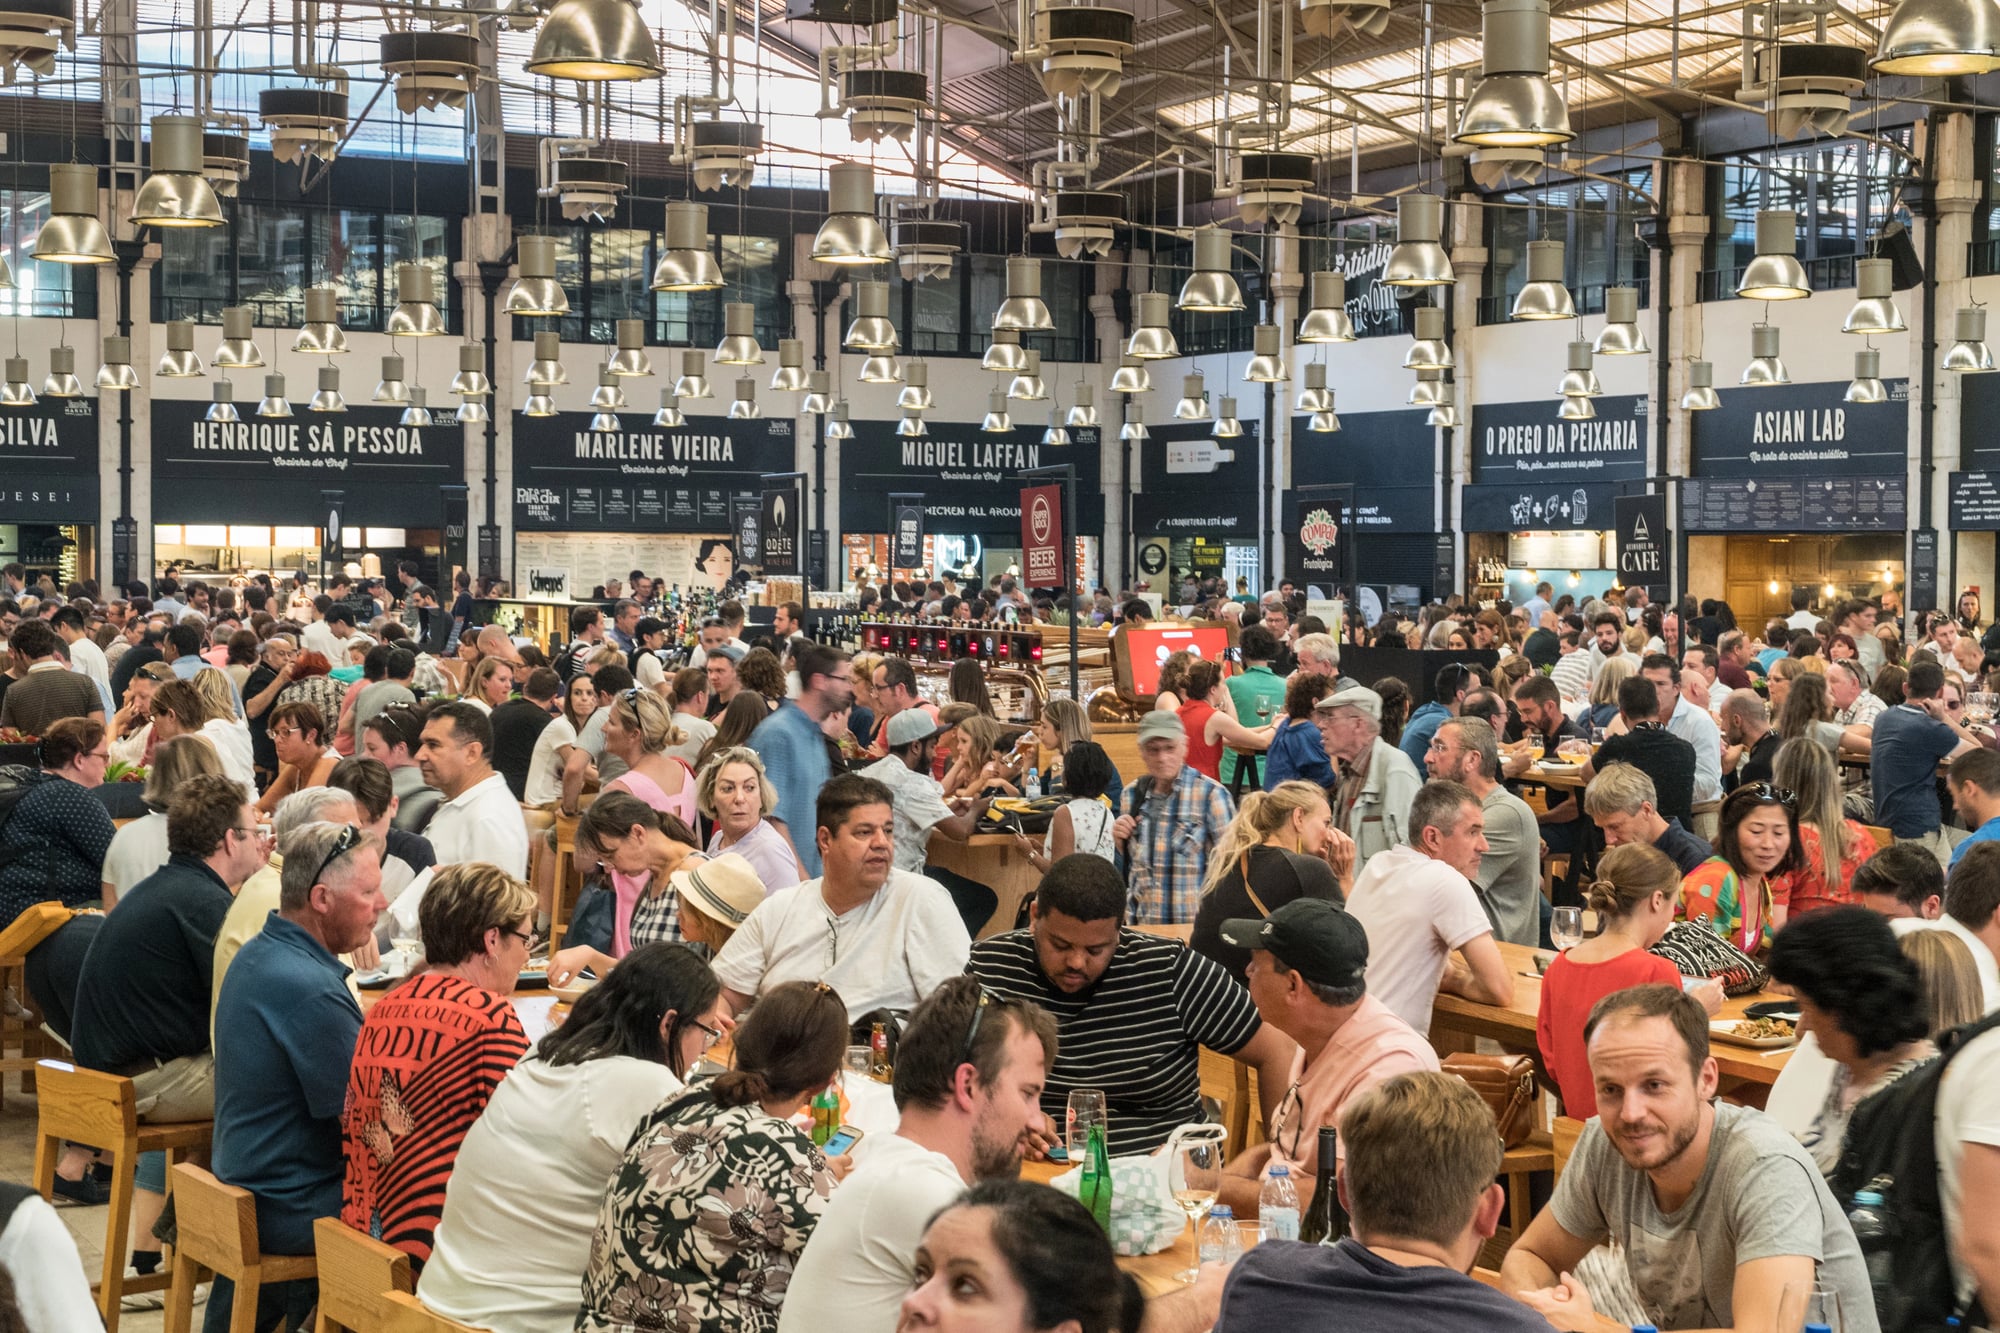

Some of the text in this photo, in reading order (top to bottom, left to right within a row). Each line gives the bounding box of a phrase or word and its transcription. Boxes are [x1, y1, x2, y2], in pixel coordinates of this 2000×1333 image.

[1752, 408, 1846, 444] ASIAN LAB
[193, 422, 300, 452] HENRIQUE
[344, 426, 422, 454] PESSOA
[1486, 420, 1638, 456] O PREGO DA PEIXARIA
[576, 432, 734, 462] MARLENE VIEIRA
[902, 442, 1038, 468] MIGUEL LAFFAN
[925, 506, 965, 516] HICKEN
[968, 507, 986, 517] ALL
[1034, 510, 1047, 519] SUPER
[1035, 519, 1047, 529] BOCK
[766, 538, 792, 554] ODETE
[1029, 550, 1056, 568] BEER
[1304, 557, 1333, 571] Frutológica
[1030, 568, 1056, 577] EXPERIENCE
